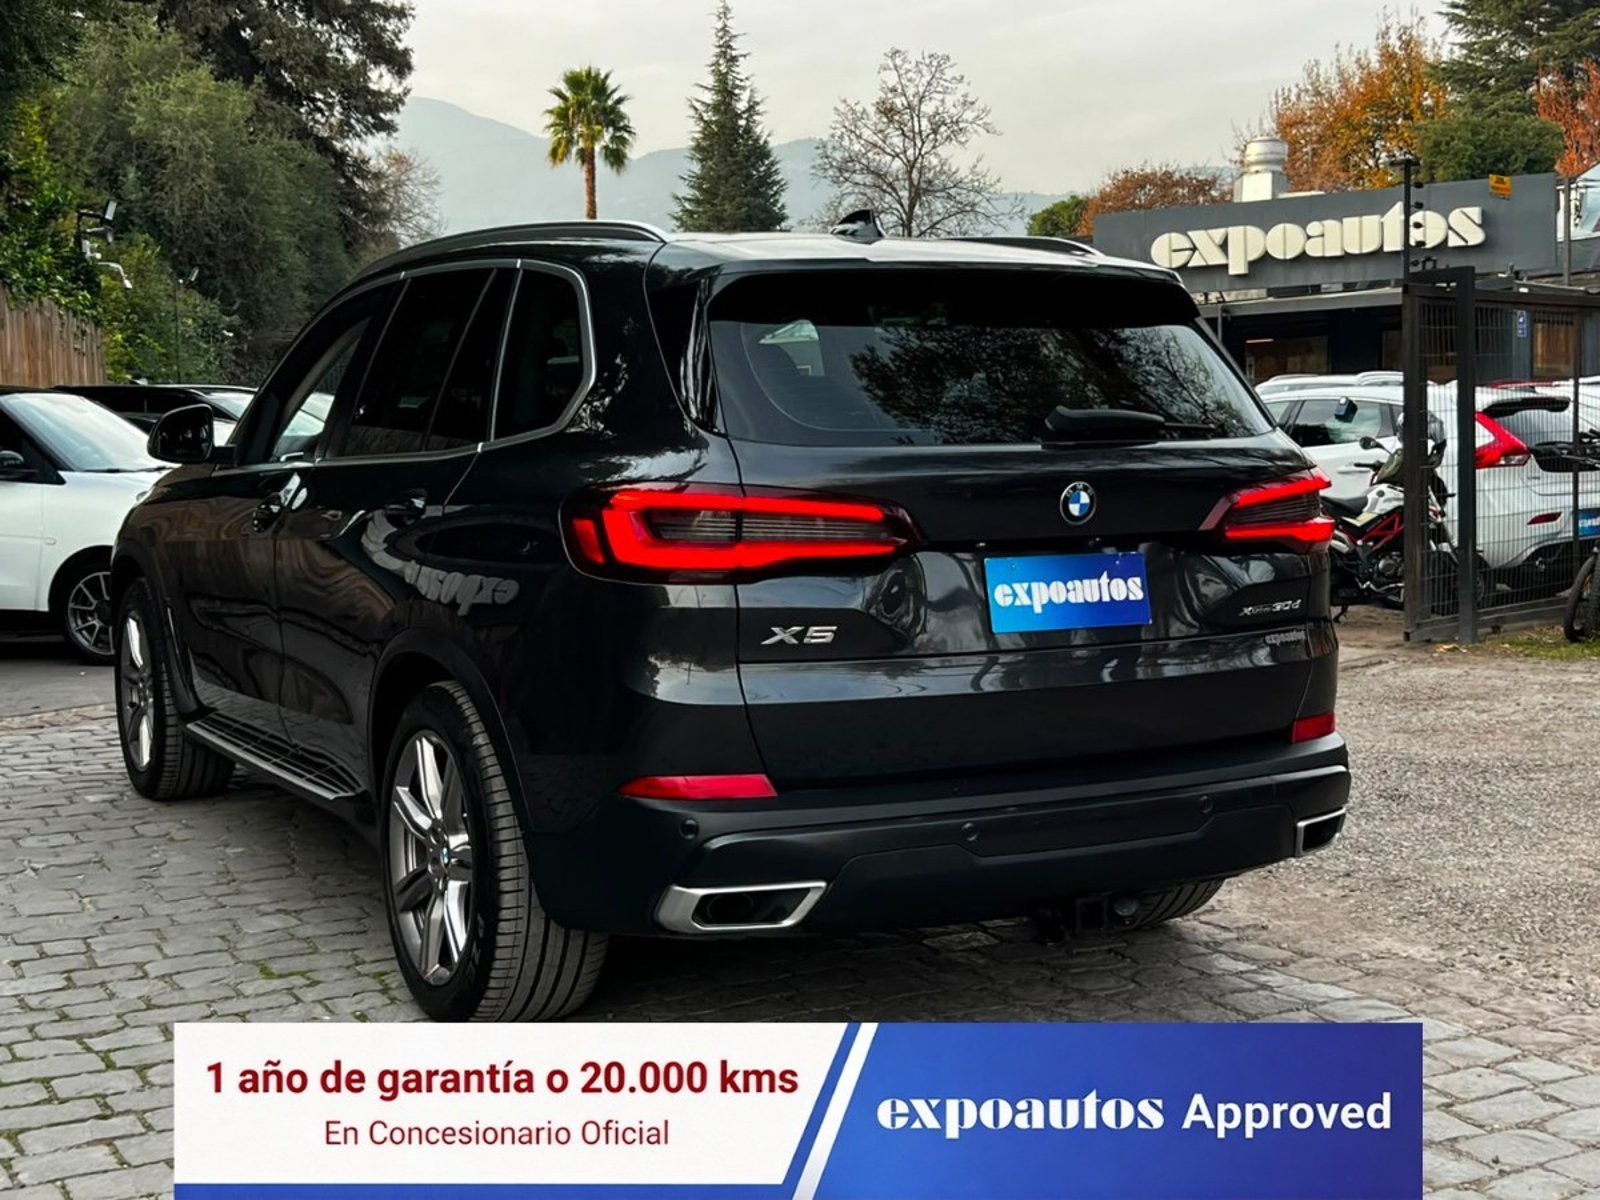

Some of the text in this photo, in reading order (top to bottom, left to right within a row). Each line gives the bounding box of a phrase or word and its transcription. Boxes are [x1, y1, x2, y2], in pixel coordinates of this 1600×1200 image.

[1150, 200, 1486, 276] expoautos
[994, 570, 1144, 614] expoautos
[760, 625, 838, 645] X5
